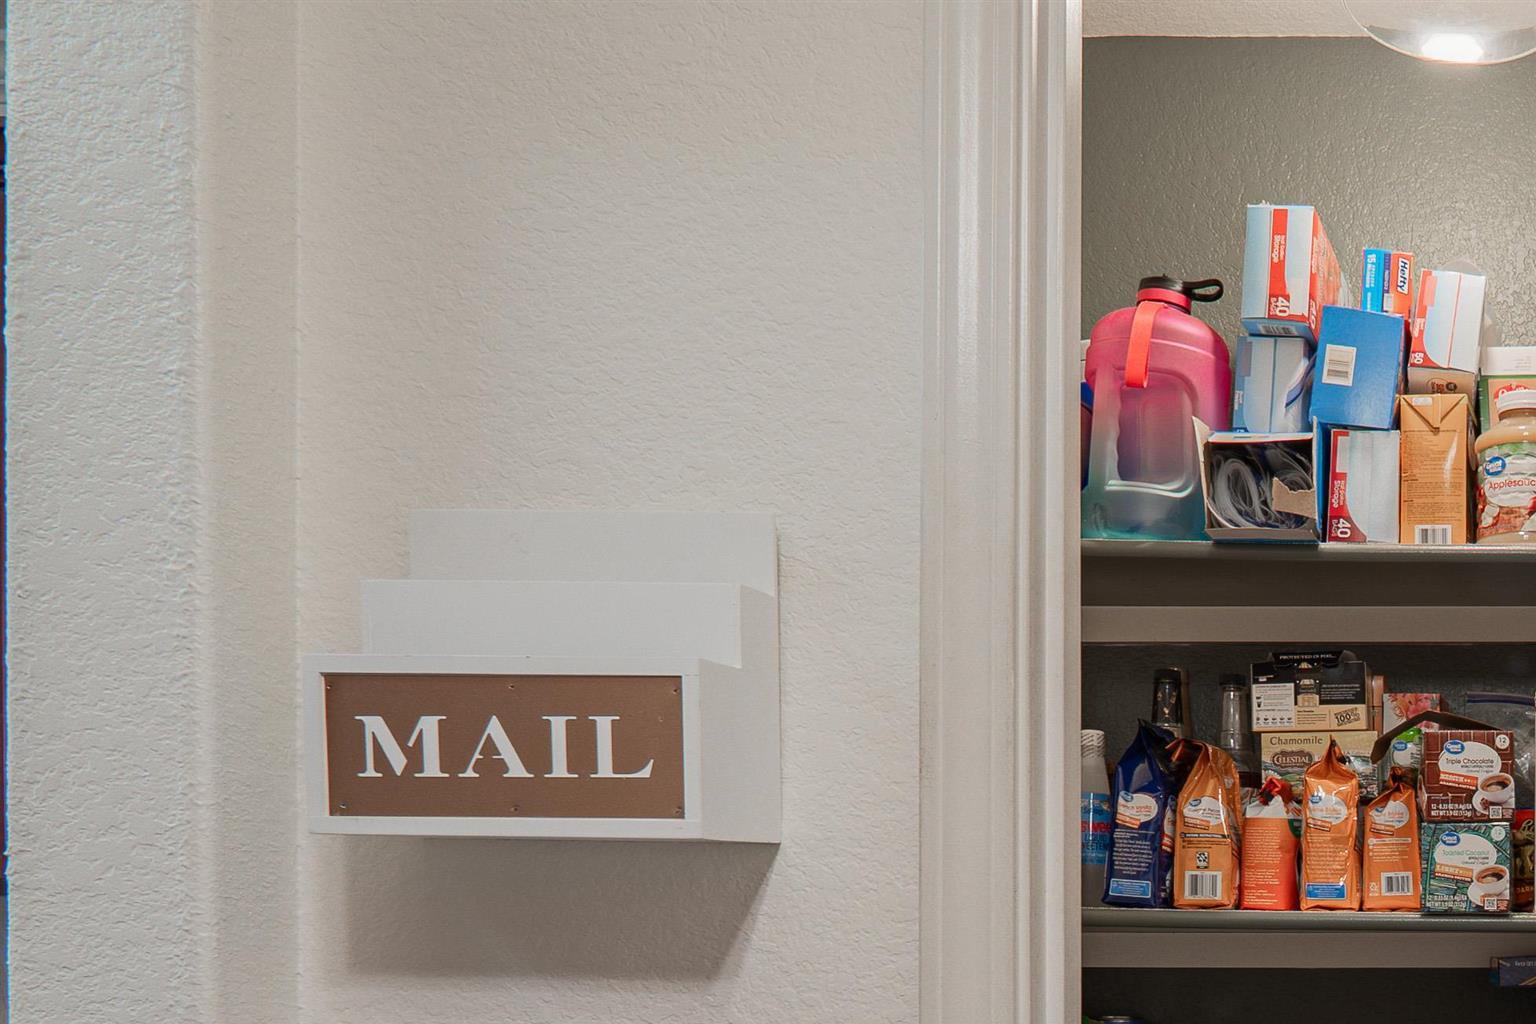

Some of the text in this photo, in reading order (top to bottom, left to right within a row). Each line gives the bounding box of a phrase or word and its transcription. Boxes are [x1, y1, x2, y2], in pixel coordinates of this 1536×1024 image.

[1272, 234, 1282, 263] Storage
[1397, 259, 1409, 292] Hefty
[1275, 296, 1291, 317] 40
[1414, 352, 1424, 363] 50
[1331, 480, 1341, 508] Storage
[1336, 518, 1351, 539] 40
[1335, 711, 1361, 724] 100%
[354, 714, 655, 779] MAIL
[1269, 736, 1324, 746] Chamomile
[1445, 757, 1495, 766] Triple Chocolate
